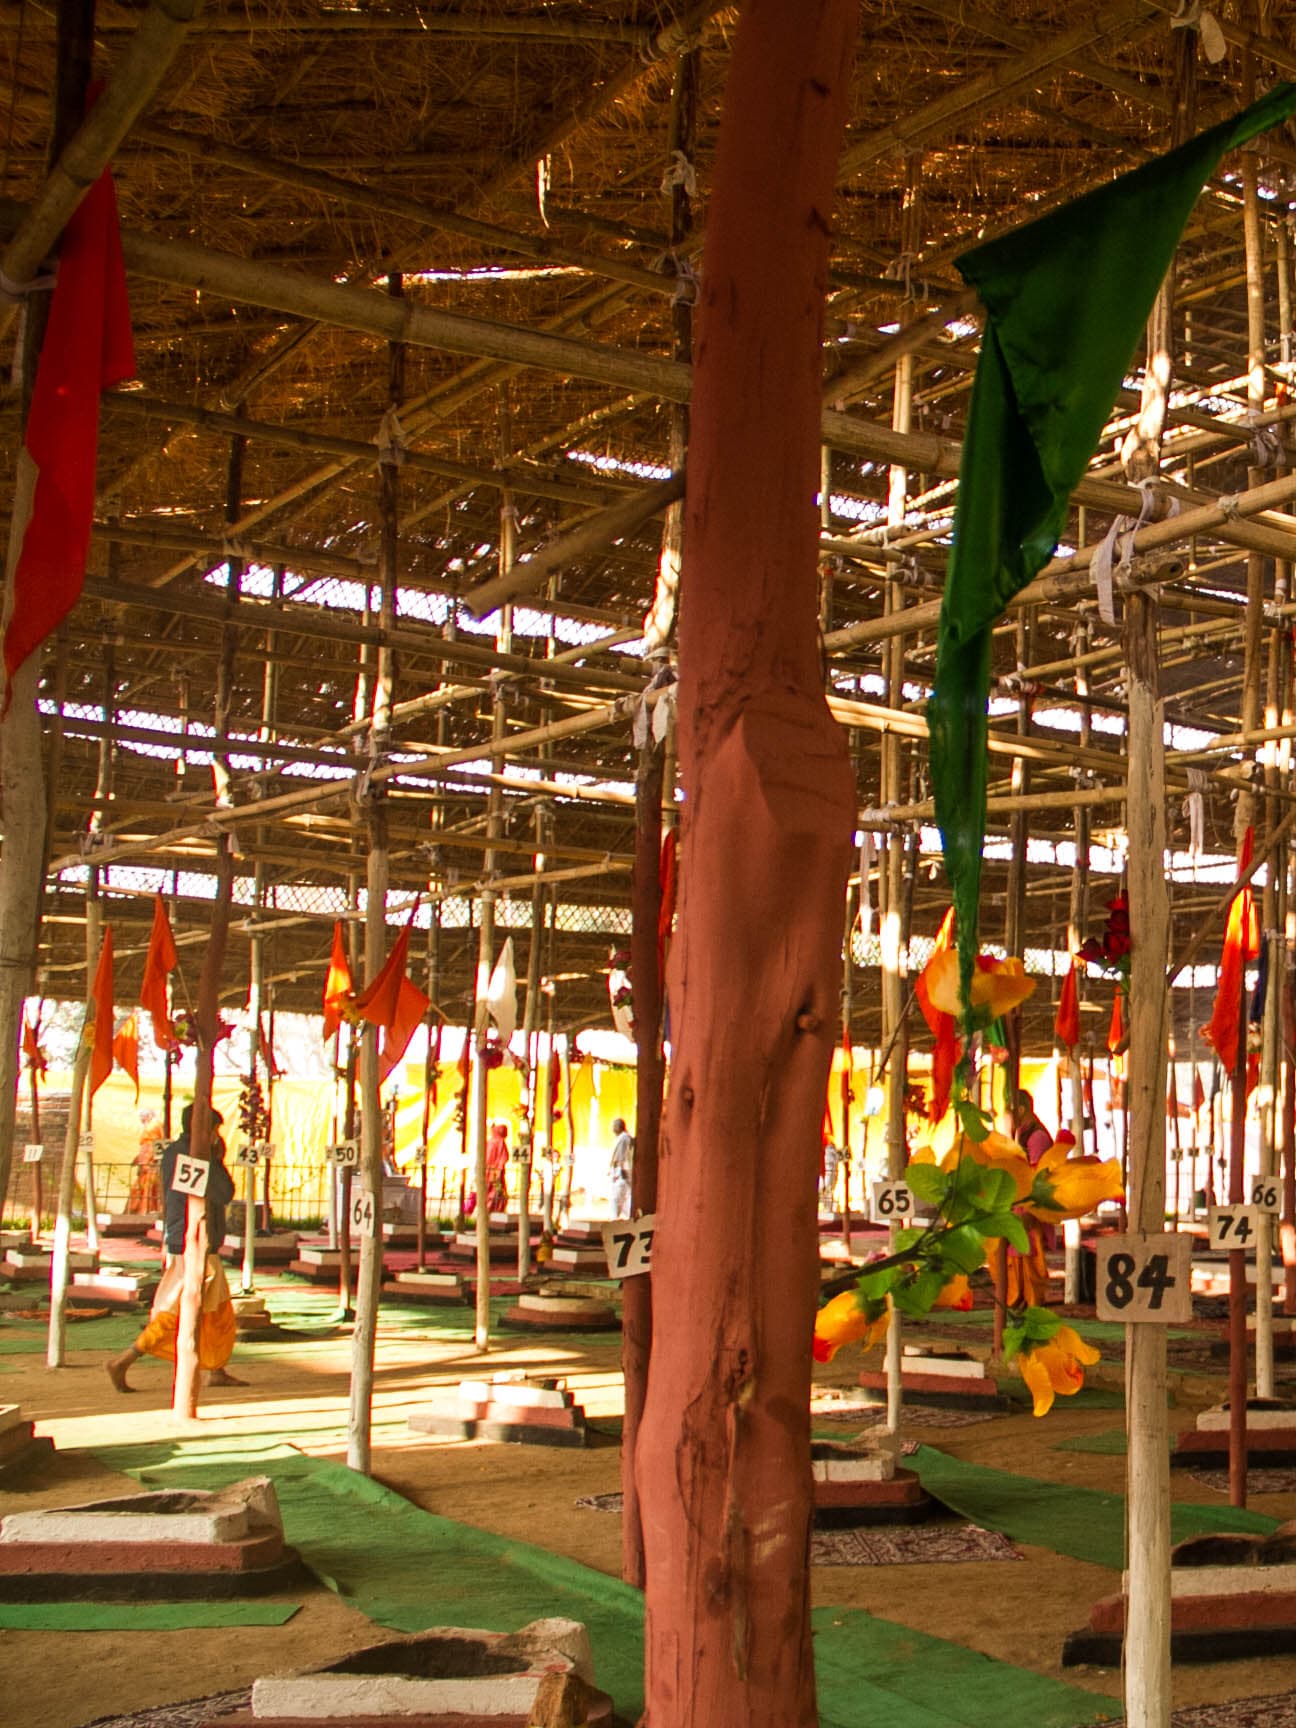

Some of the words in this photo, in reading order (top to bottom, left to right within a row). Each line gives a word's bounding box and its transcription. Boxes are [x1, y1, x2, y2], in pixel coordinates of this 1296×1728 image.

[239, 1147, 258, 1164] 43
[336, 1147, 354, 1162] 50
[513, 1148, 529, 1162] 44
[178, 1163, 205, 1189] 57
[878, 1189, 910, 1214] 65
[1252, 1184, 1276, 1207] 66
[353, 1198, 372, 1230] 64
[1217, 1215, 1253, 1244] 74
[1105, 1252, 1176, 1310] 84
